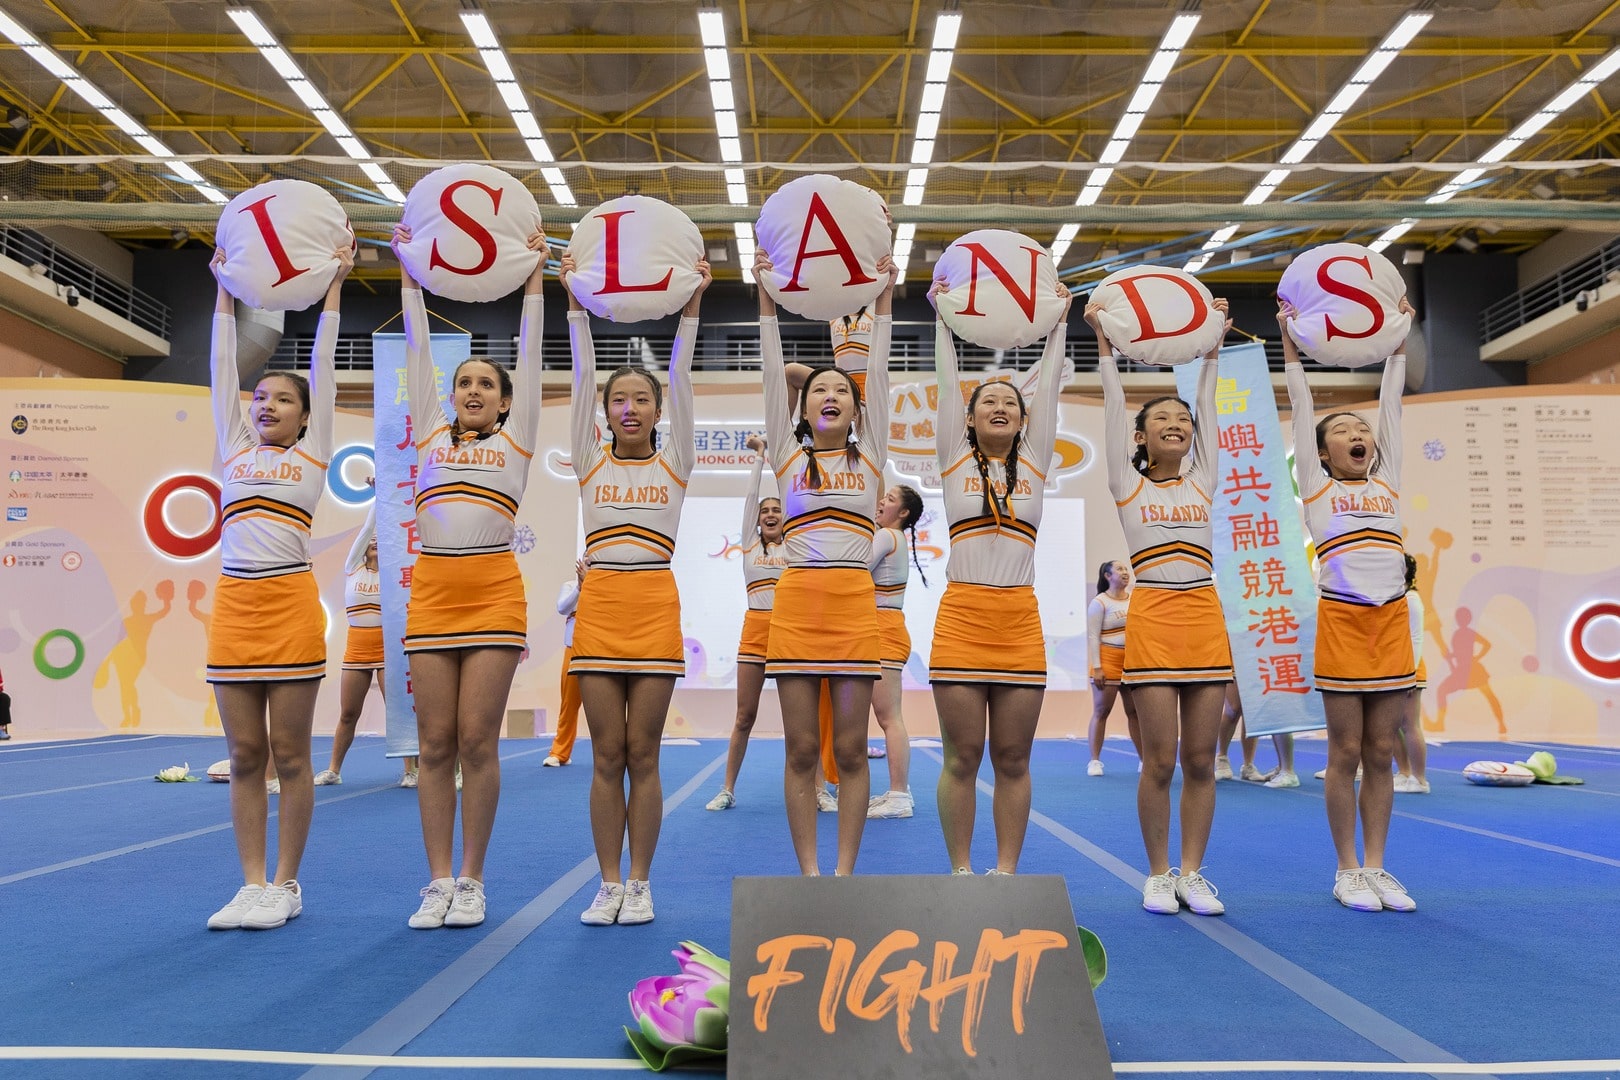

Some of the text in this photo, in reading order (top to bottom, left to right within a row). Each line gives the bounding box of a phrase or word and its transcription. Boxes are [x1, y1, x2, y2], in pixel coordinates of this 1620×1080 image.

[833, 322, 872, 335] ISLDS
[428, 447, 506, 468] ISLANDS
[697, 455, 735, 465] HONG
[897, 460, 916, 472] The
[228, 462, 303, 482] ISLANDS
[792, 471, 866, 493] ISANDS
[594, 485, 669, 504] ISLANDS
[963, 476, 1032, 496] ISADS
[1140, 504, 1209, 524] ISLANDS
[1330, 493, 1396, 515] ISLANDS
[753, 555, 788, 566] ISLAN
[354, 581, 381, 593] ISLAN
[747, 928, 1068, 1057] FIGHT
